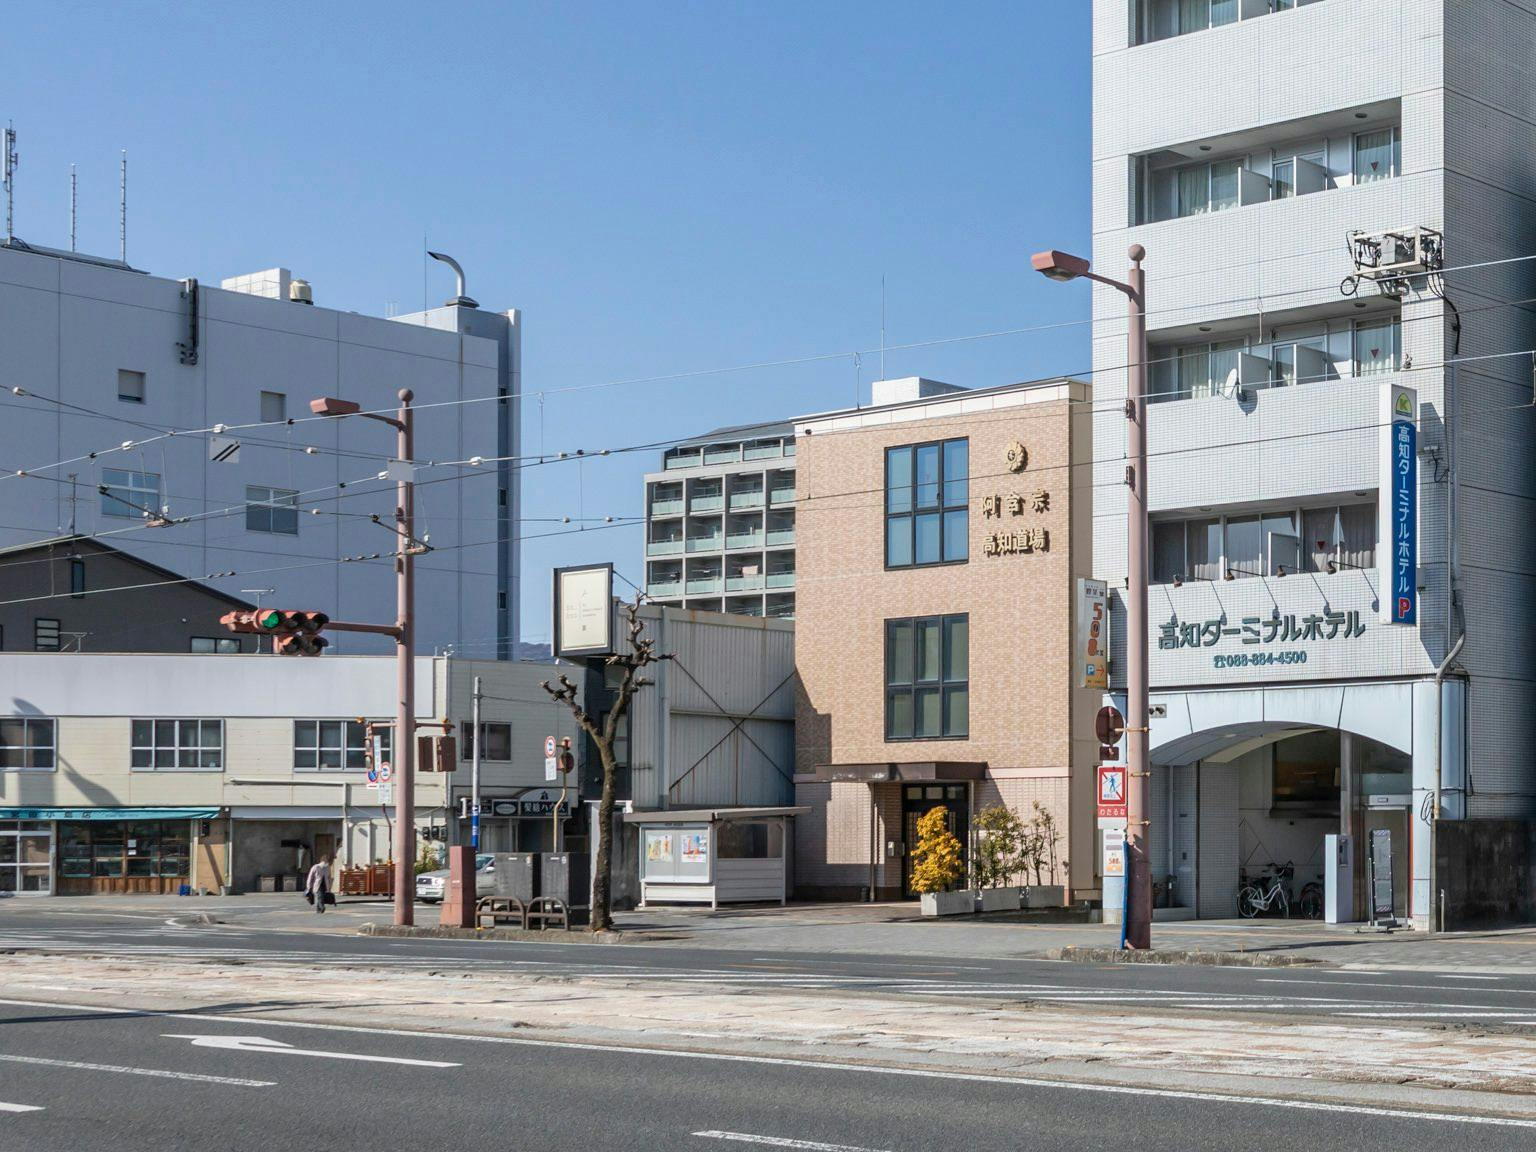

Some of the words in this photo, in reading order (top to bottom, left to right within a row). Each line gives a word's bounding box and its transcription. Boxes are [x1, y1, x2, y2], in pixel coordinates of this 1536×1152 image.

[1398, 425, 1410, 593] 高知ターミナルホテル
[982, 527, 1047, 554] 高知道場
[1398, 597, 1411, 618] P
[1158, 610, 1366, 650] 高知ターミナルホテル
[1226, 650, 1307, 667] 088-884-4500
